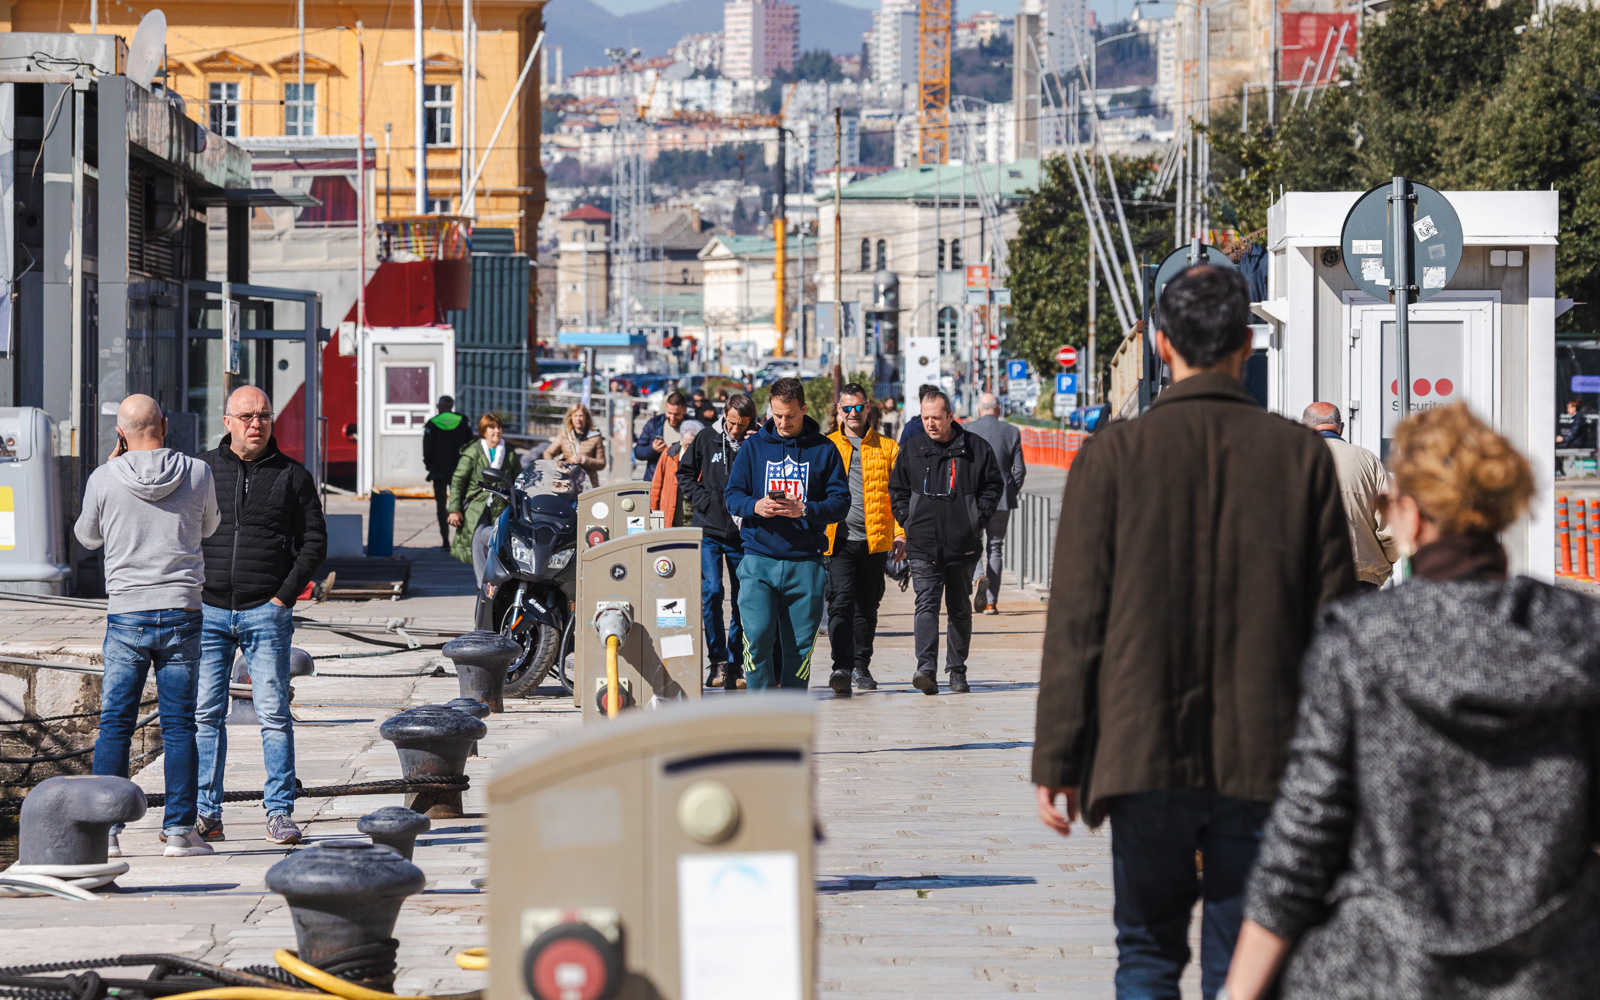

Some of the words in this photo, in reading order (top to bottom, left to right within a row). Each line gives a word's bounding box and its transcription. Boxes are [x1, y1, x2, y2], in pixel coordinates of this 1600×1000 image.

[1012, 363, 1022, 377] P
[1060, 376, 1073, 391] P
[1392, 400, 1452, 411] Scuritas
[770, 480, 802, 500] NFL
